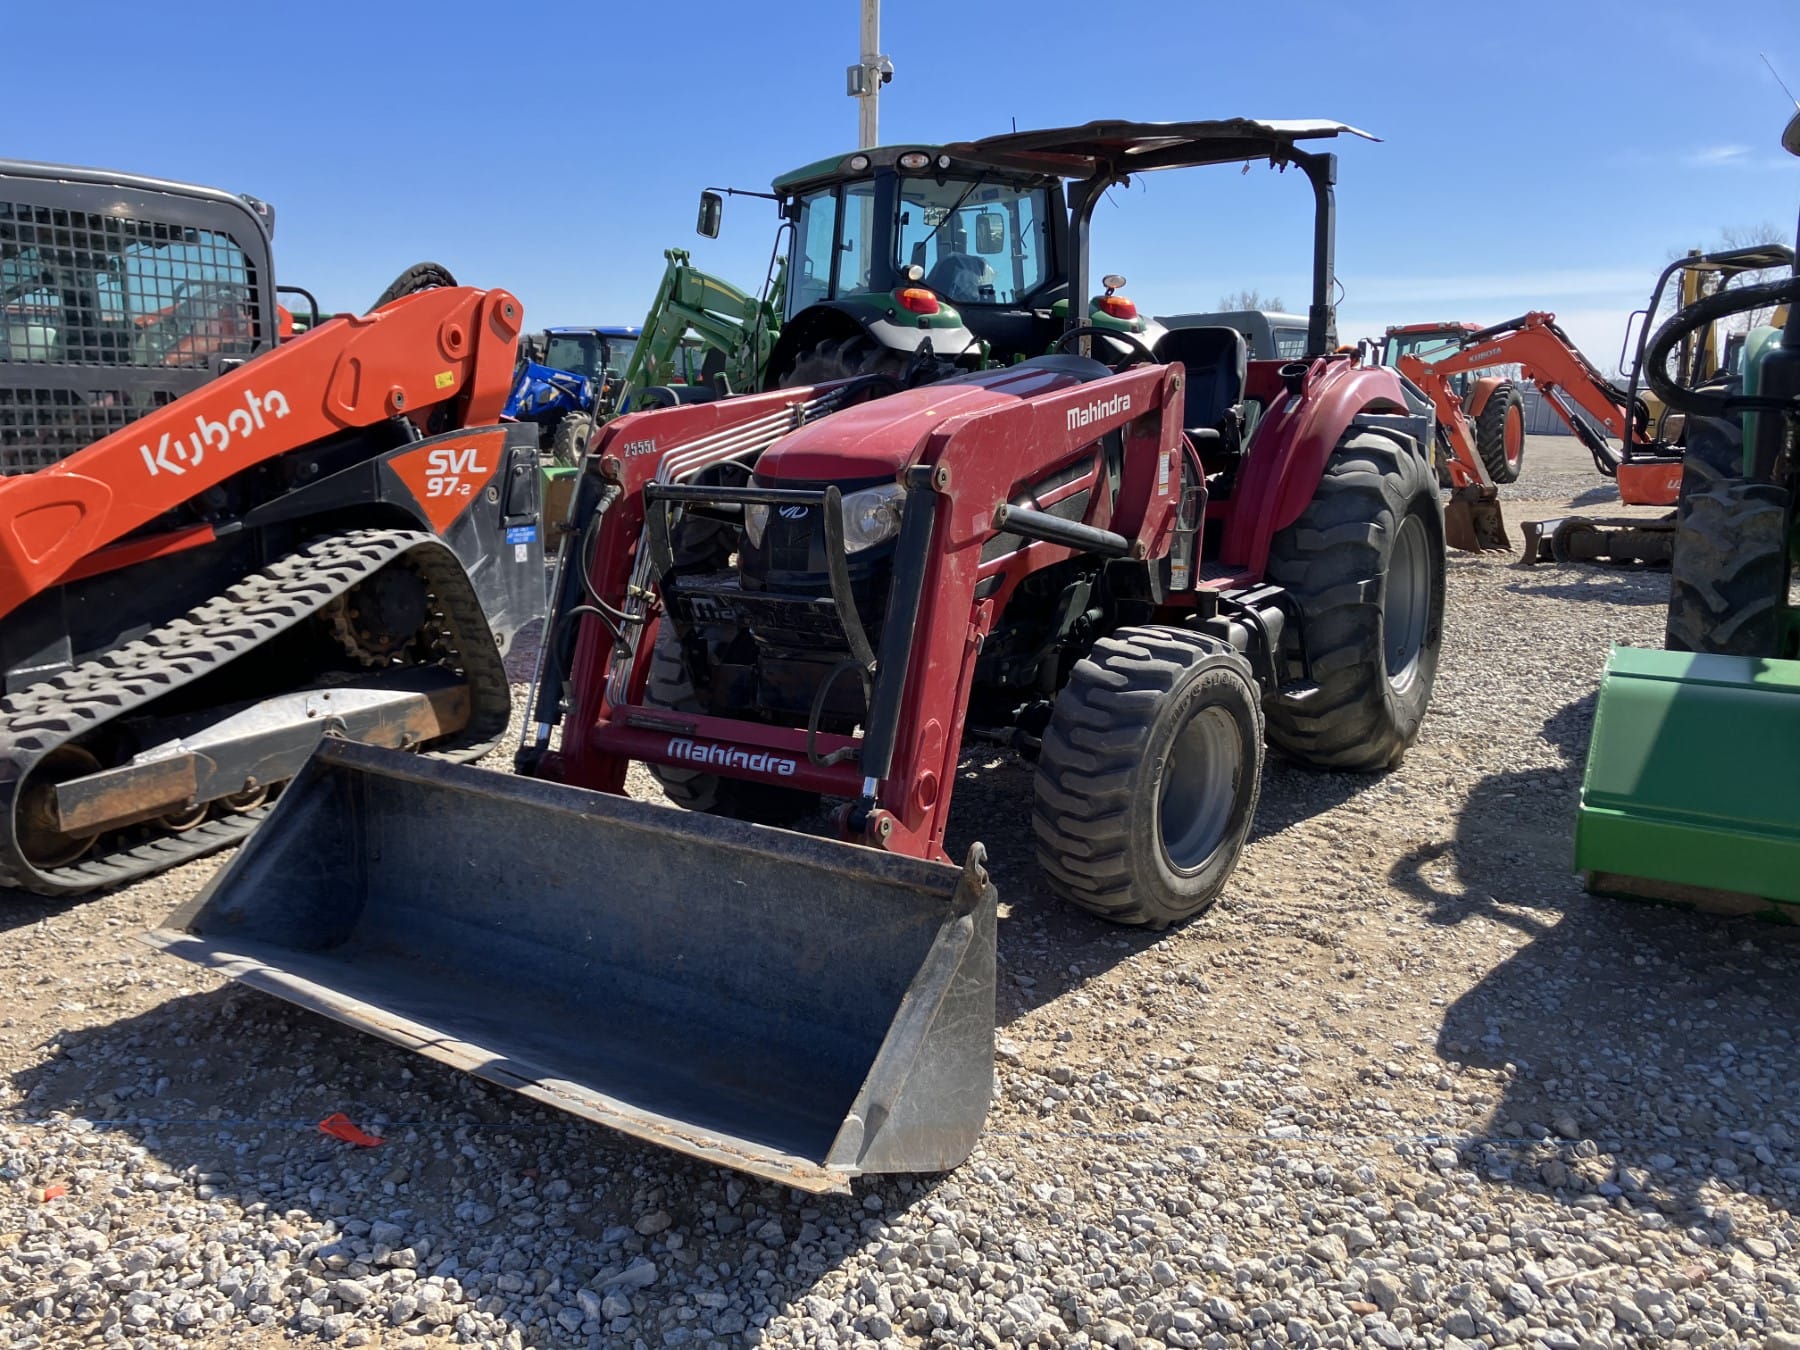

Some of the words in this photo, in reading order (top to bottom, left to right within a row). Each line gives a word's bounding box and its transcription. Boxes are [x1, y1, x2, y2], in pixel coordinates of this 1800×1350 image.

[1467, 346, 1502, 362] KUBOTA
[1066, 393, 1131, 432] Mahindra
[139, 389, 291, 476] Kubota
[623, 439, 657, 458] 2555L
[425, 449, 488, 475] SVL
[667, 737, 797, 776] Mahindra
